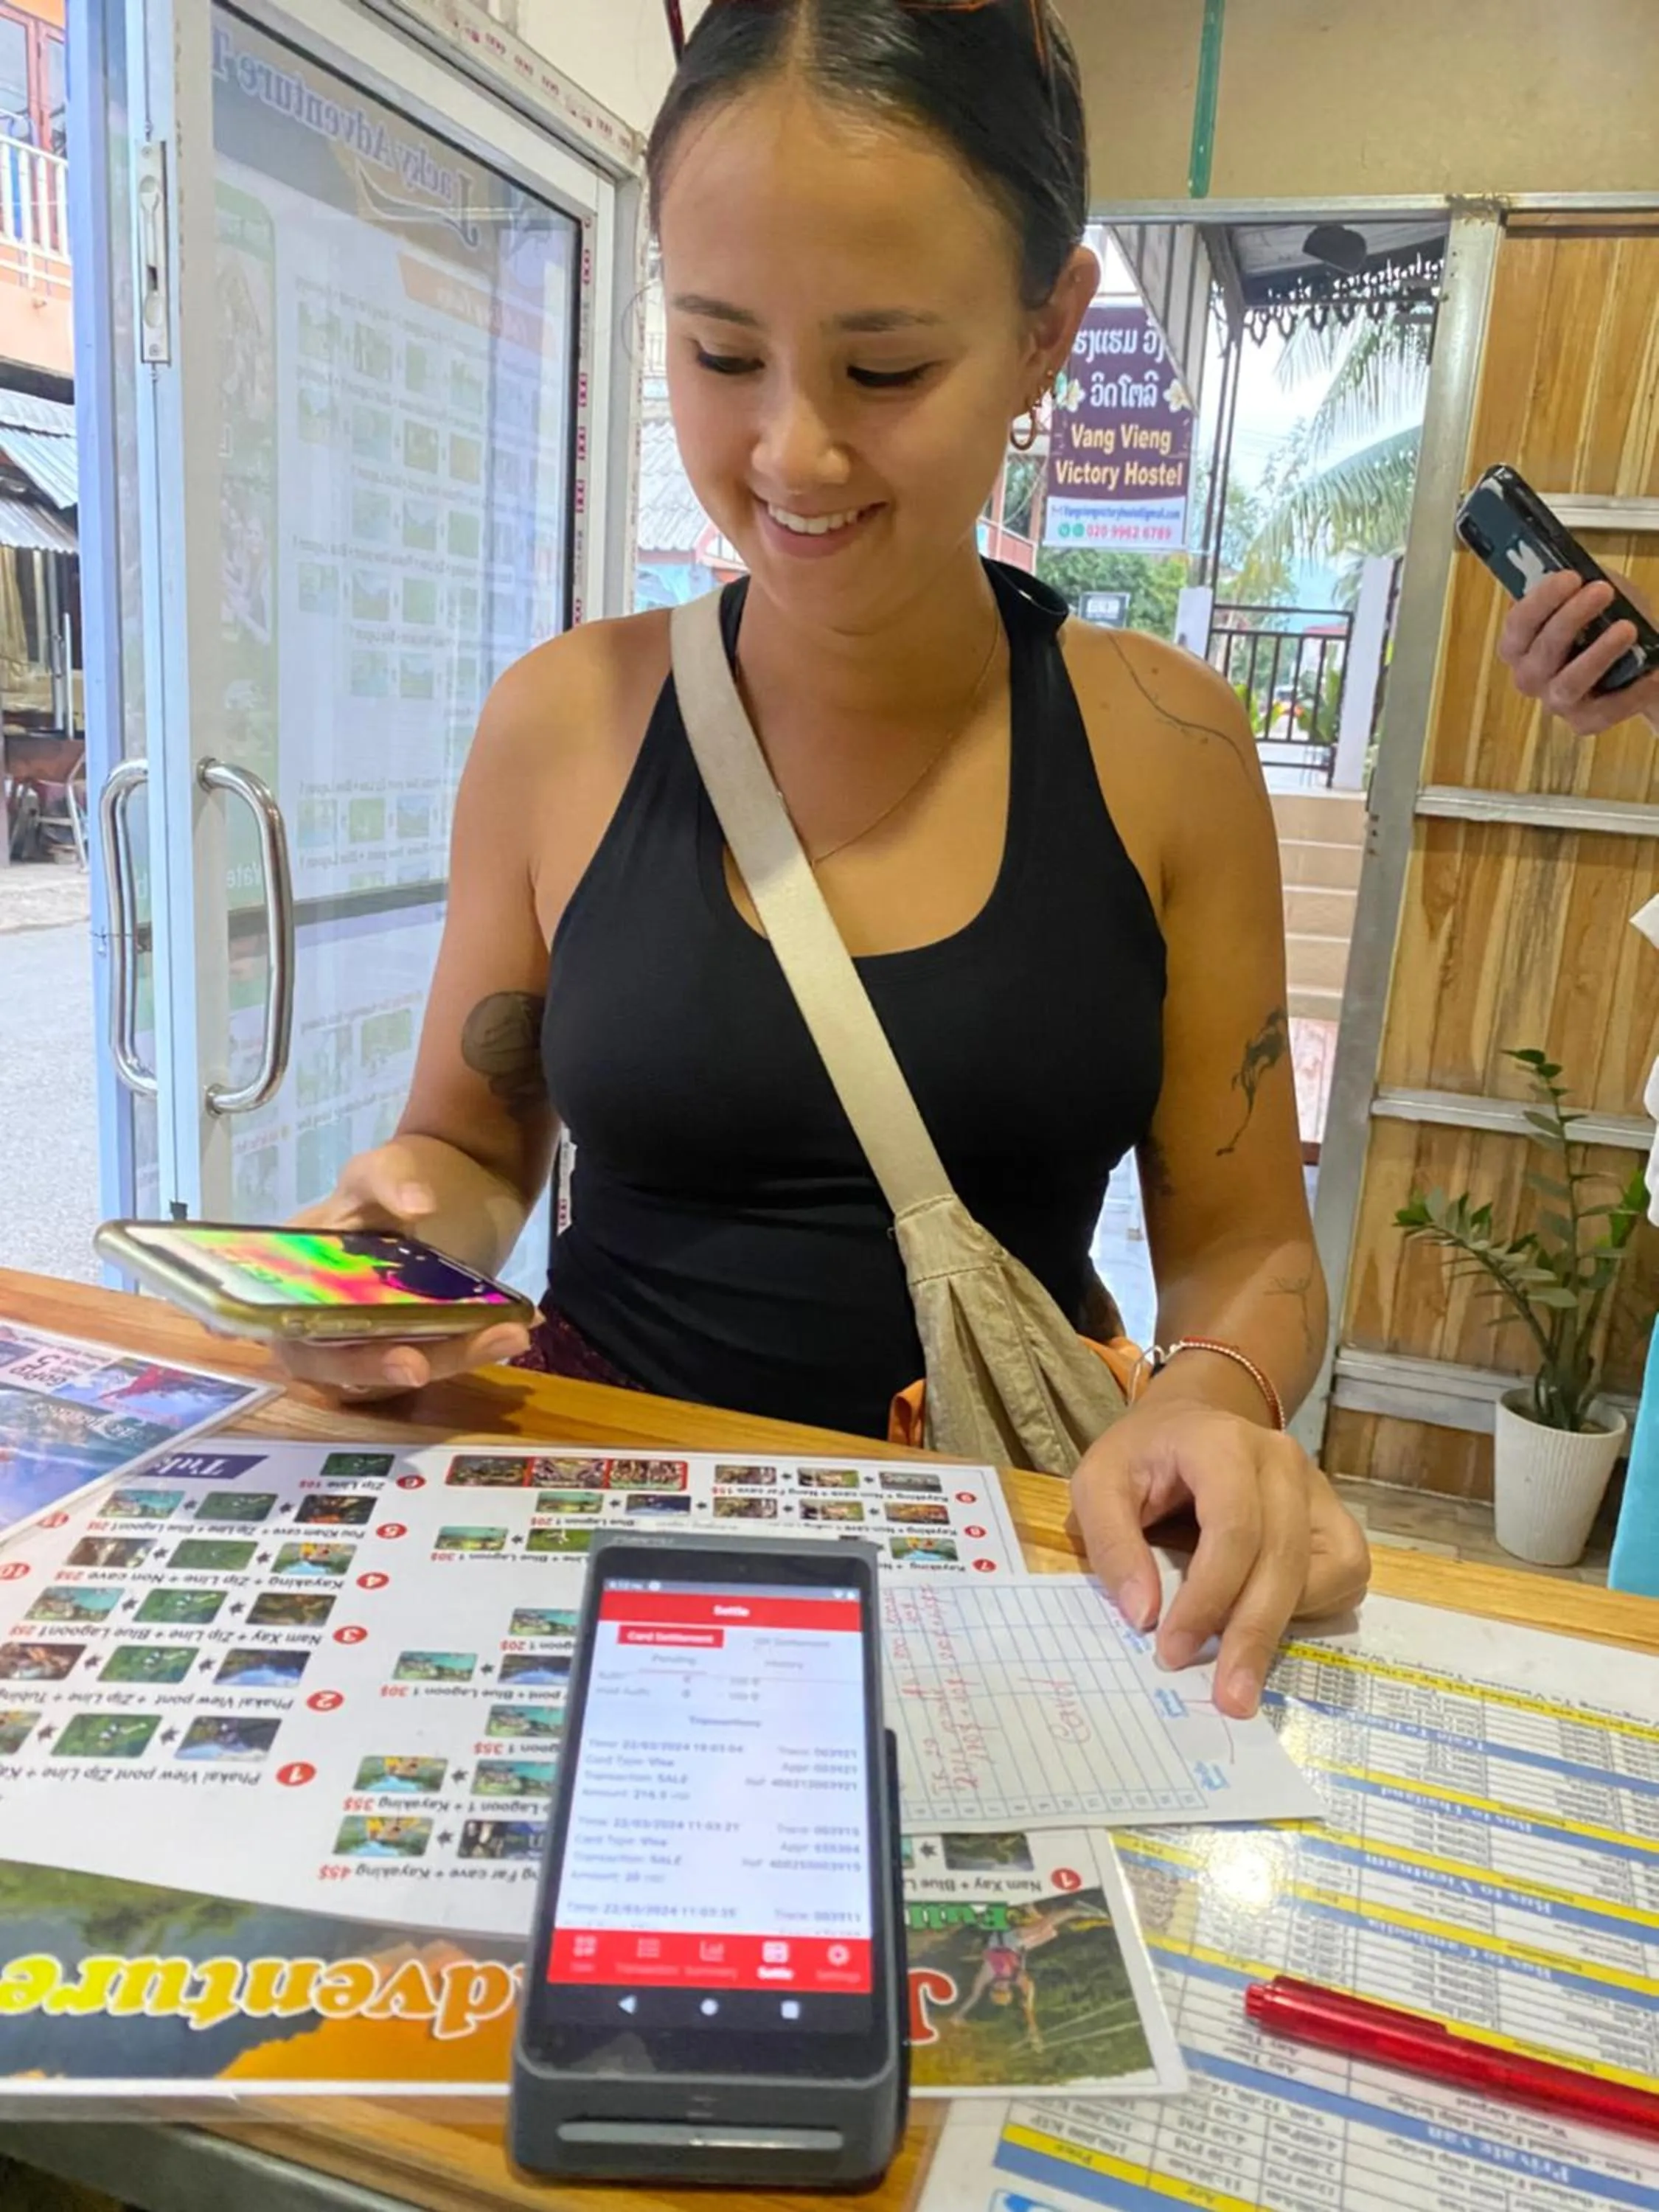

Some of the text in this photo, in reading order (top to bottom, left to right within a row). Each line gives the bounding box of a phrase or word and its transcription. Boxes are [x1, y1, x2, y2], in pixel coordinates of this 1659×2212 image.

[1071, 423, 1172, 455] Vang Vieng
[1055, 461, 1183, 491] Victory Hostel
[158, 1770, 198, 1784] View
[378, 1798, 449, 1812] Kayaking
[355, 1864, 431, 1879] Kayaking
[449, 1868, 487, 1879] cave
[974, 1876, 1003, 1891] Xay
[1006, 1879, 1042, 1893] Nam
[0, 1952, 525, 2040] dventure
